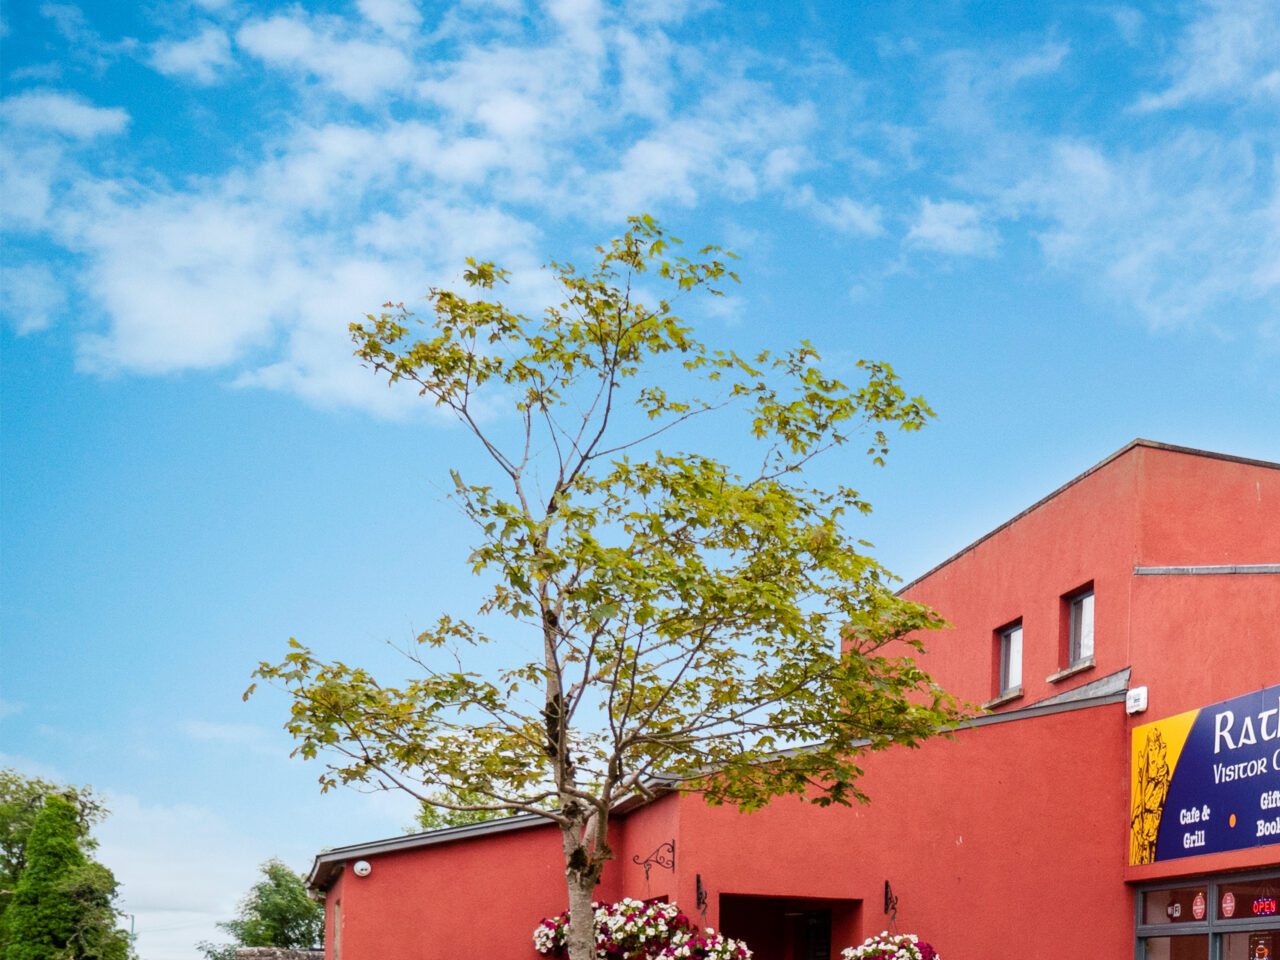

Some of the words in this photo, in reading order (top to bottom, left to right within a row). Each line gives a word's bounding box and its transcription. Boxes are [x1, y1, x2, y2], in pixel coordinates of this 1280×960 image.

[1180, 807, 1200, 824] Cafe
[1201, 804, 1210, 820] &
[1183, 830, 1205, 848] Grill
[1253, 900, 1276, 913] OPEN
